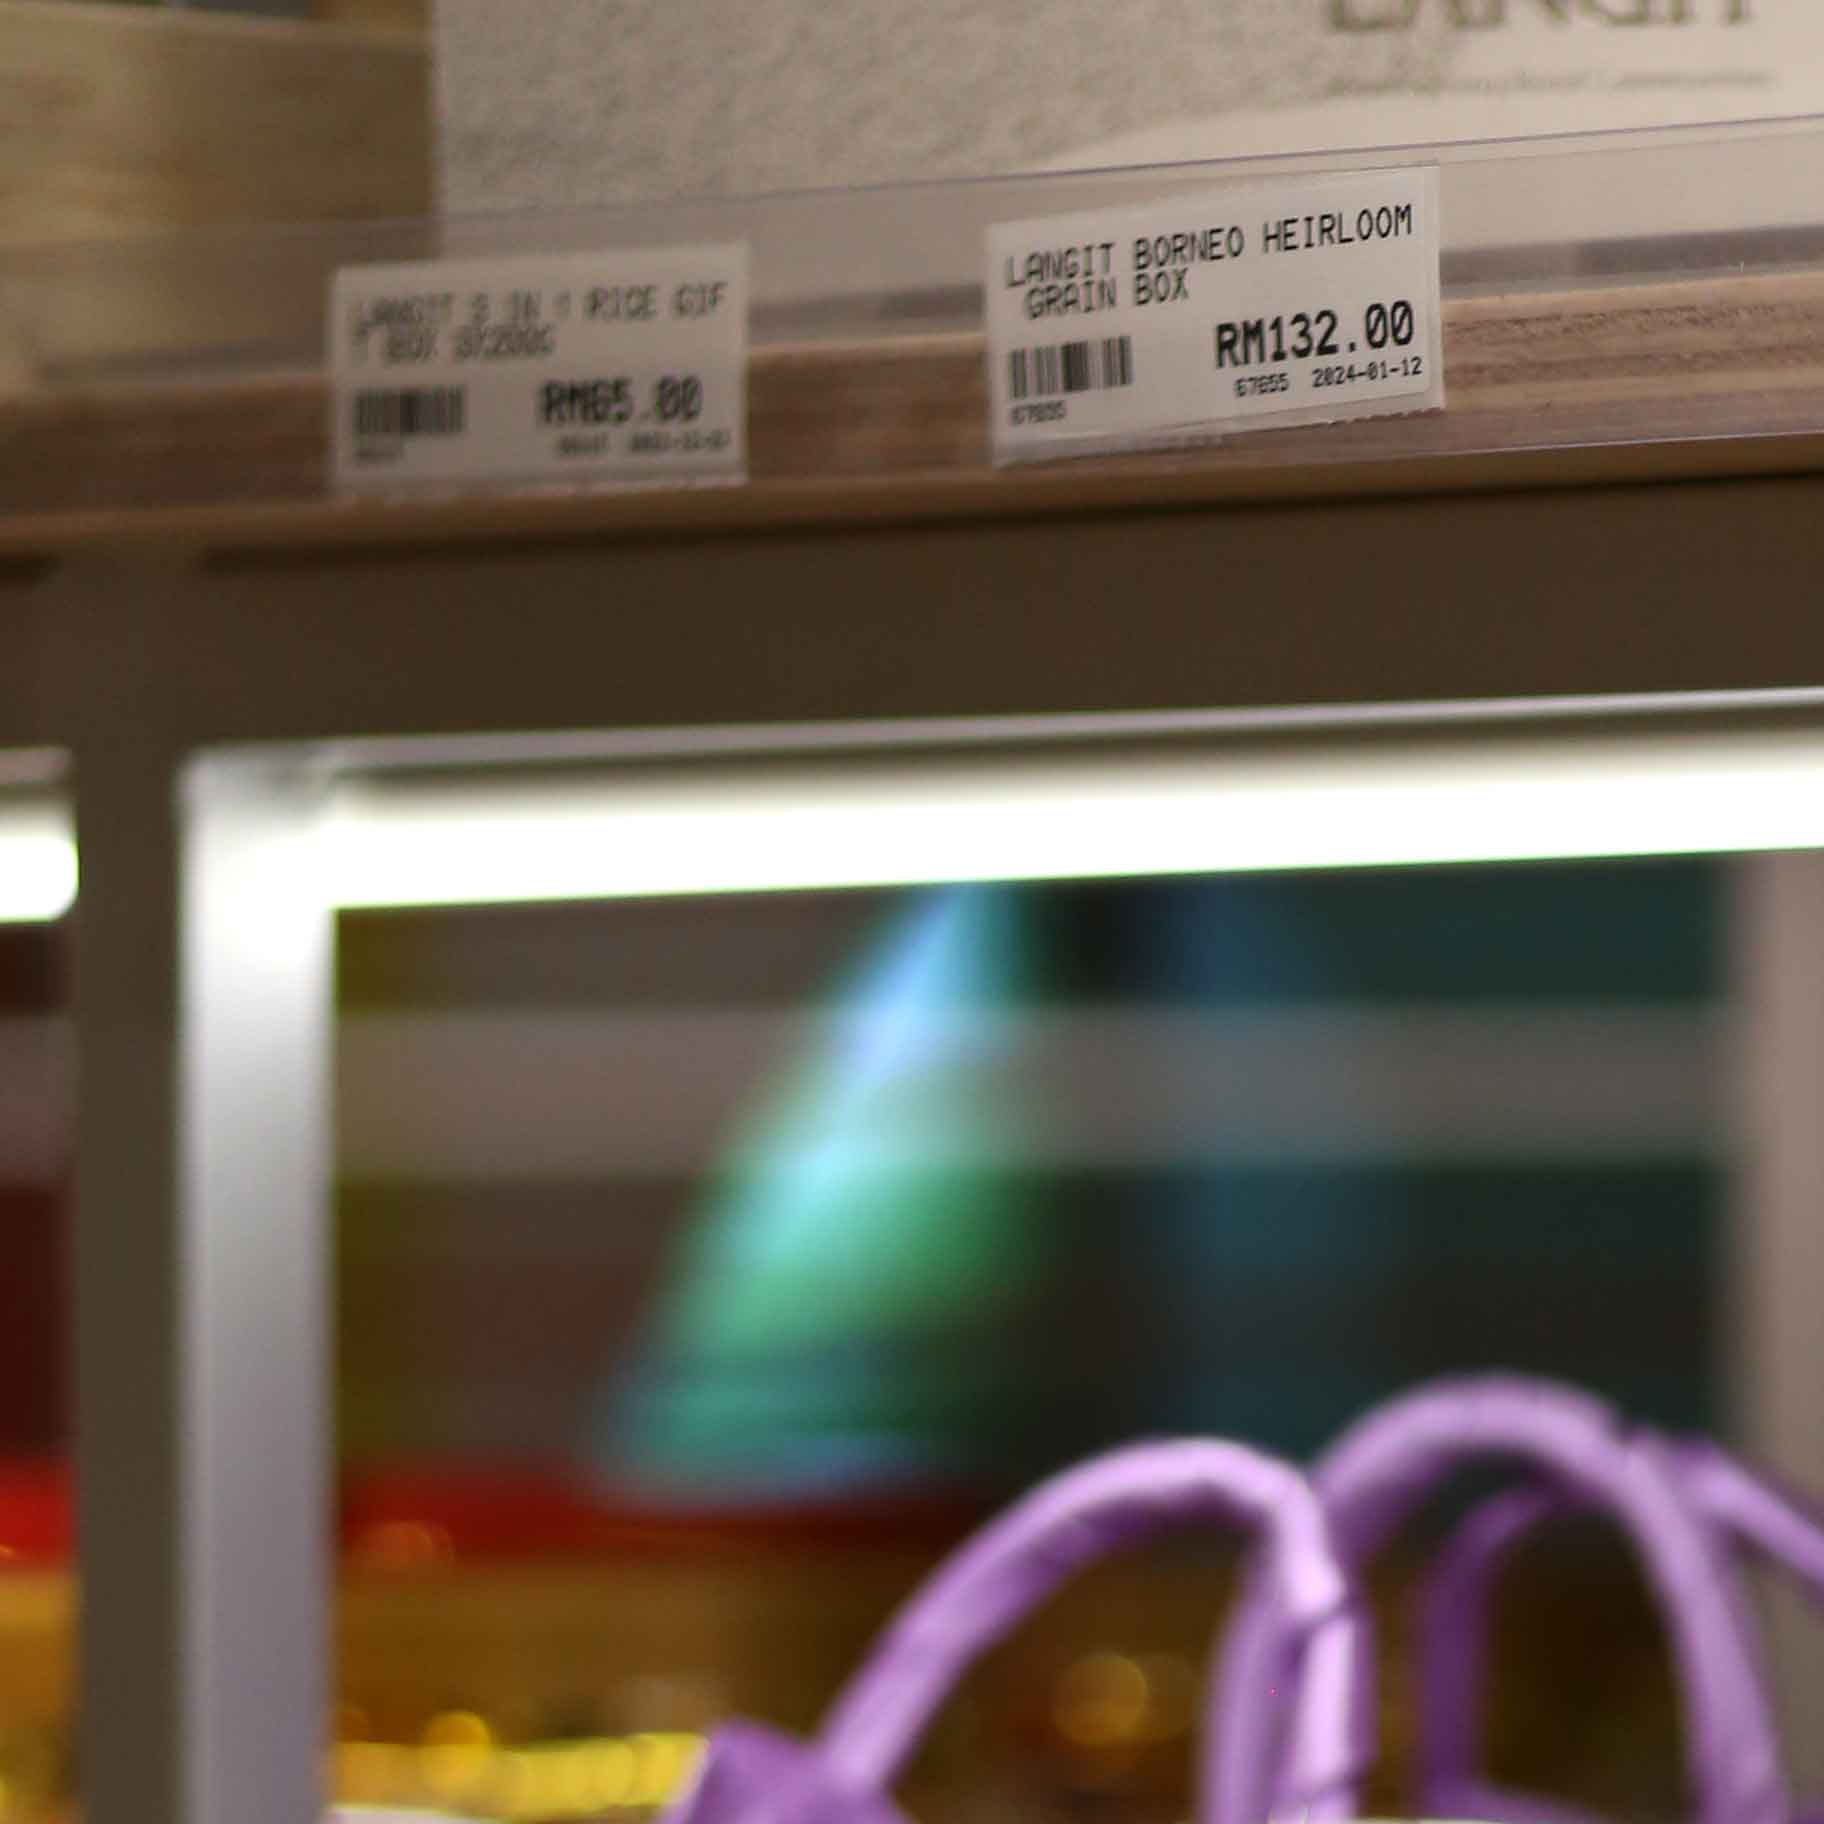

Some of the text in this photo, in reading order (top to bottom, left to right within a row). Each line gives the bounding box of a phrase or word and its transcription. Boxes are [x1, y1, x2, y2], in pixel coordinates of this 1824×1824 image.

[1005, 203, 1413, 288] LANGIT BORNEO HEIRLOOM
[1024, 267, 1189, 320] GRAIN BOX
[1215, 299, 1416, 370] RM132.00
[1311, 355, 1424, 389] 2024-01-12
